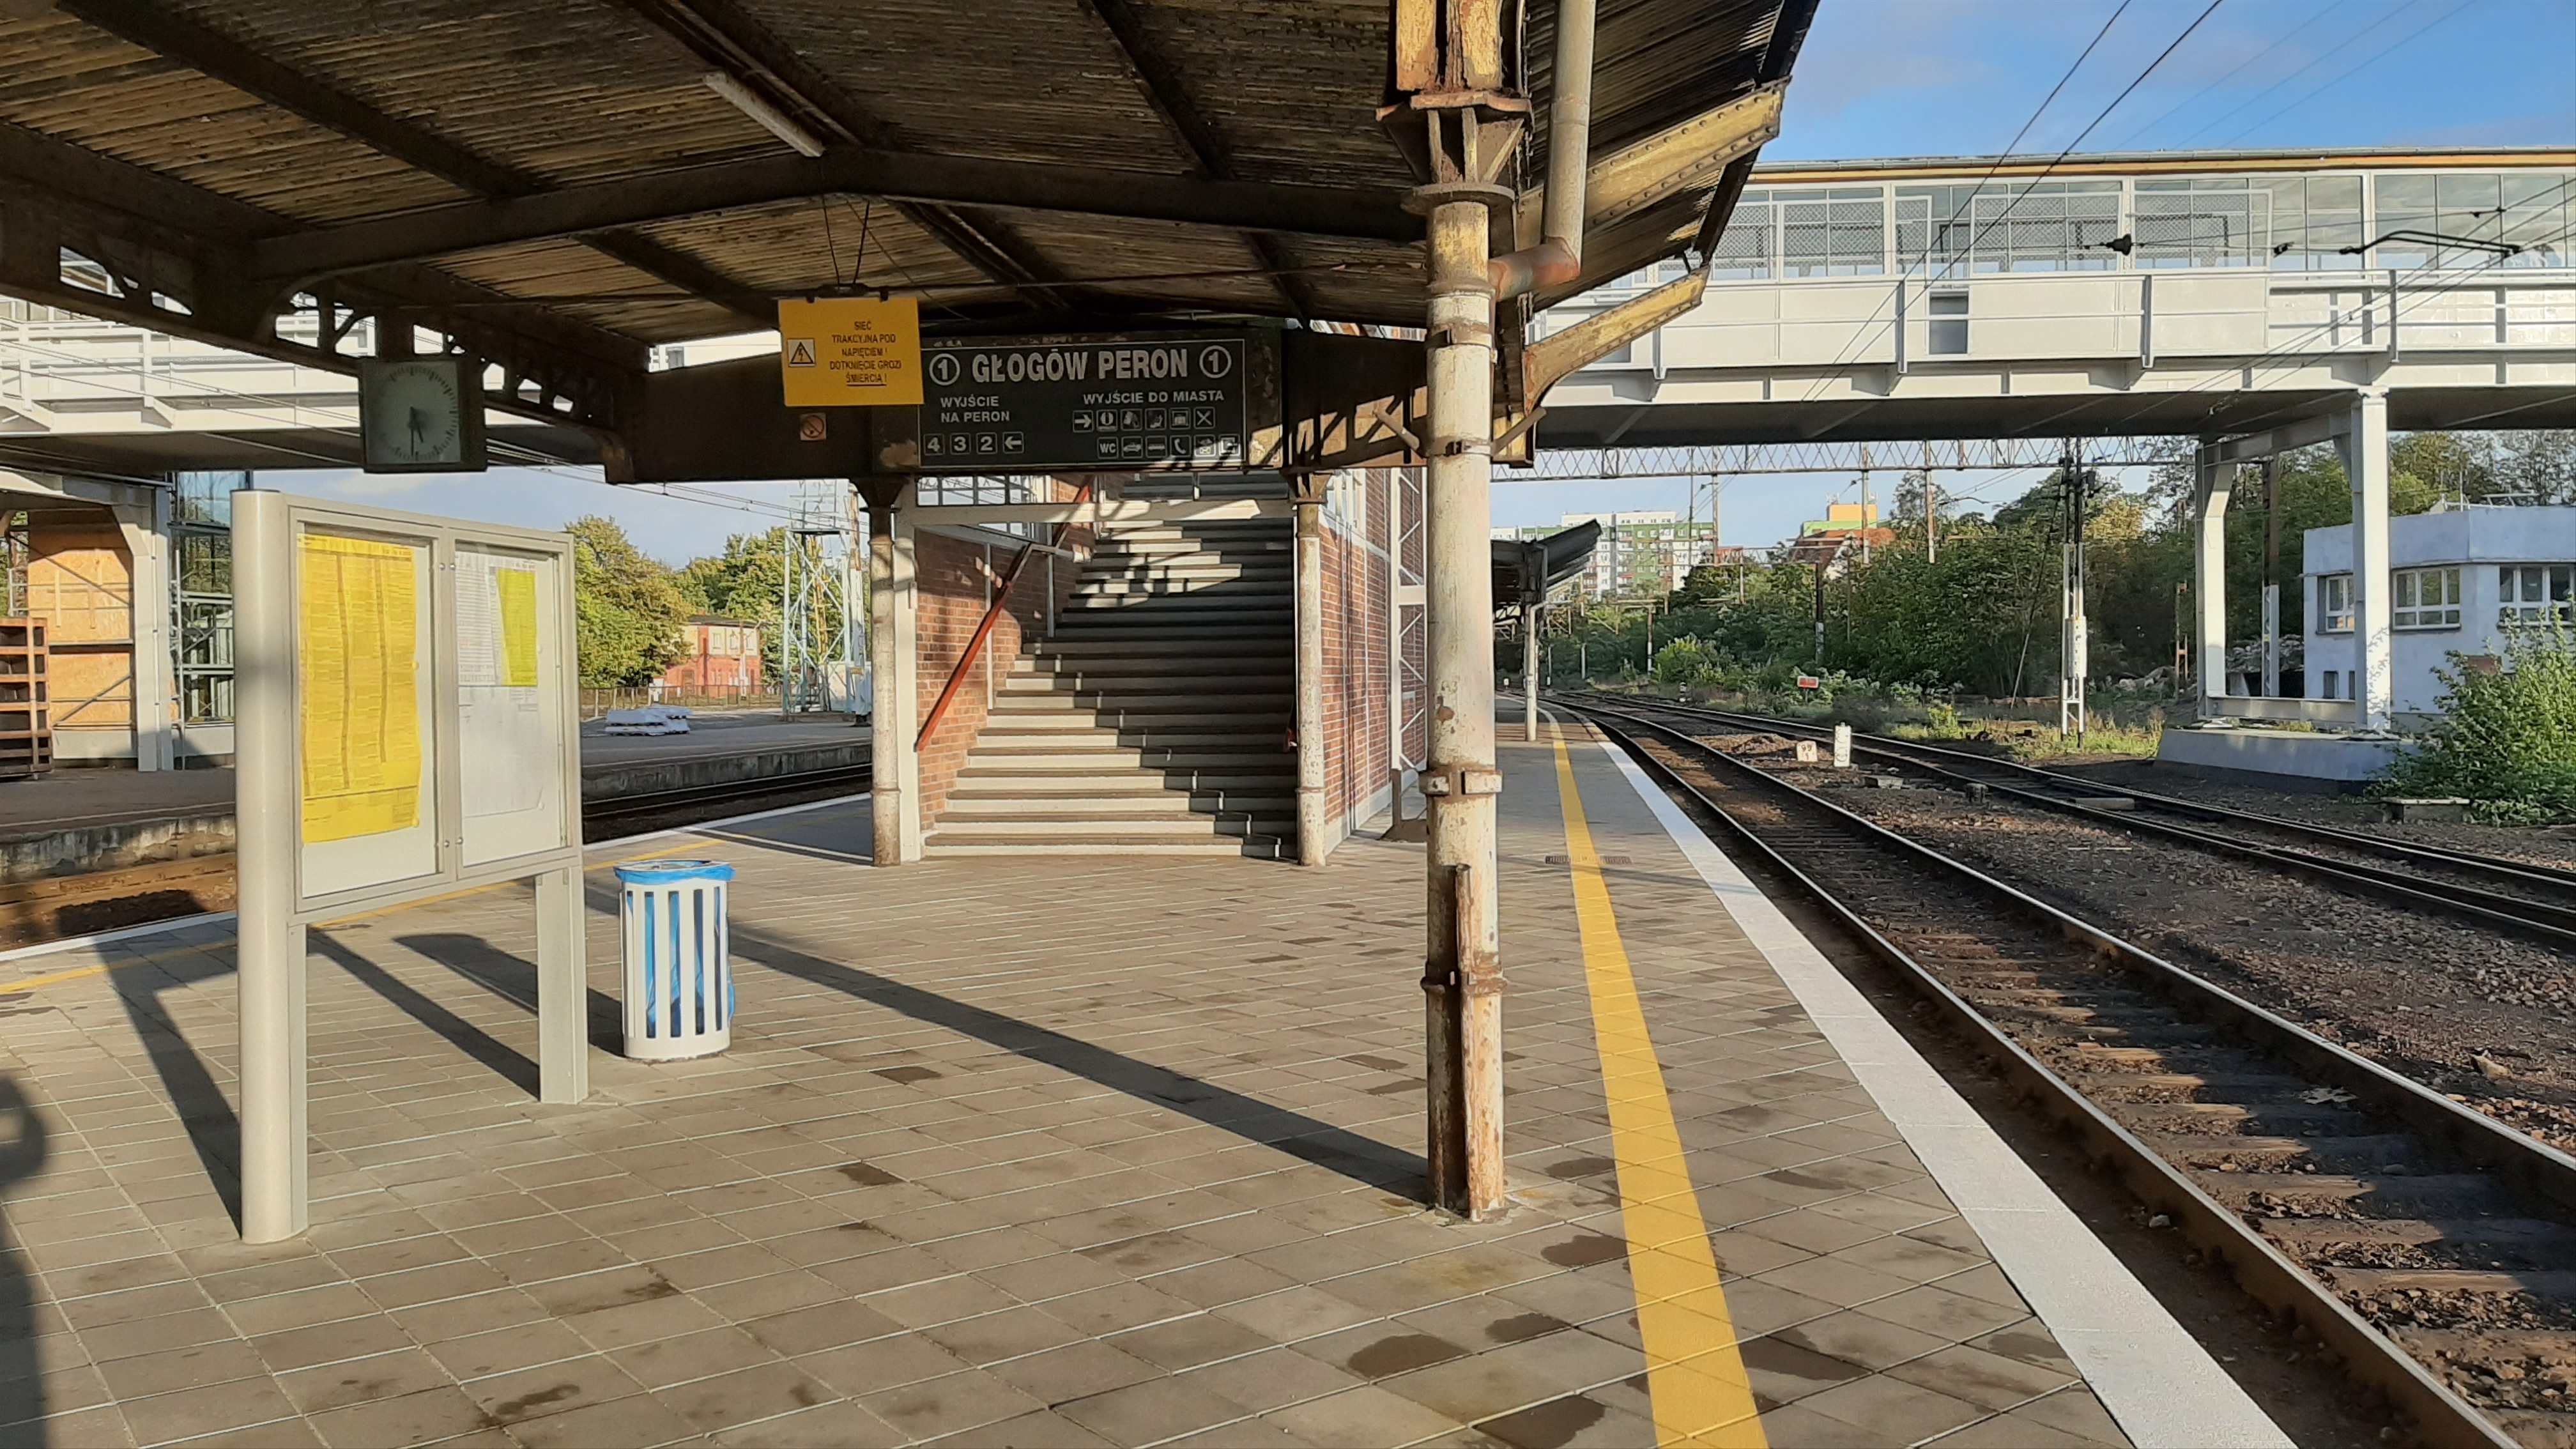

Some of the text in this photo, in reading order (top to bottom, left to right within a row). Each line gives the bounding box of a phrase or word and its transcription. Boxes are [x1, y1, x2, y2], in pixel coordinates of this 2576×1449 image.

[832, 334, 896, 343] TRAKCYJNA POD
[878, 360, 901, 369] GROZI
[1098, 349, 1188, 379] PERON
[940, 394, 999, 408] WYJŚCIE
[1083, 390, 1224, 405] WYJŚCIE DO MIASTA
[940, 411, 1010, 422] NA PERON
[928, 436, 993, 452] 4 3 2
[1100, 442, 1116, 453] WC
